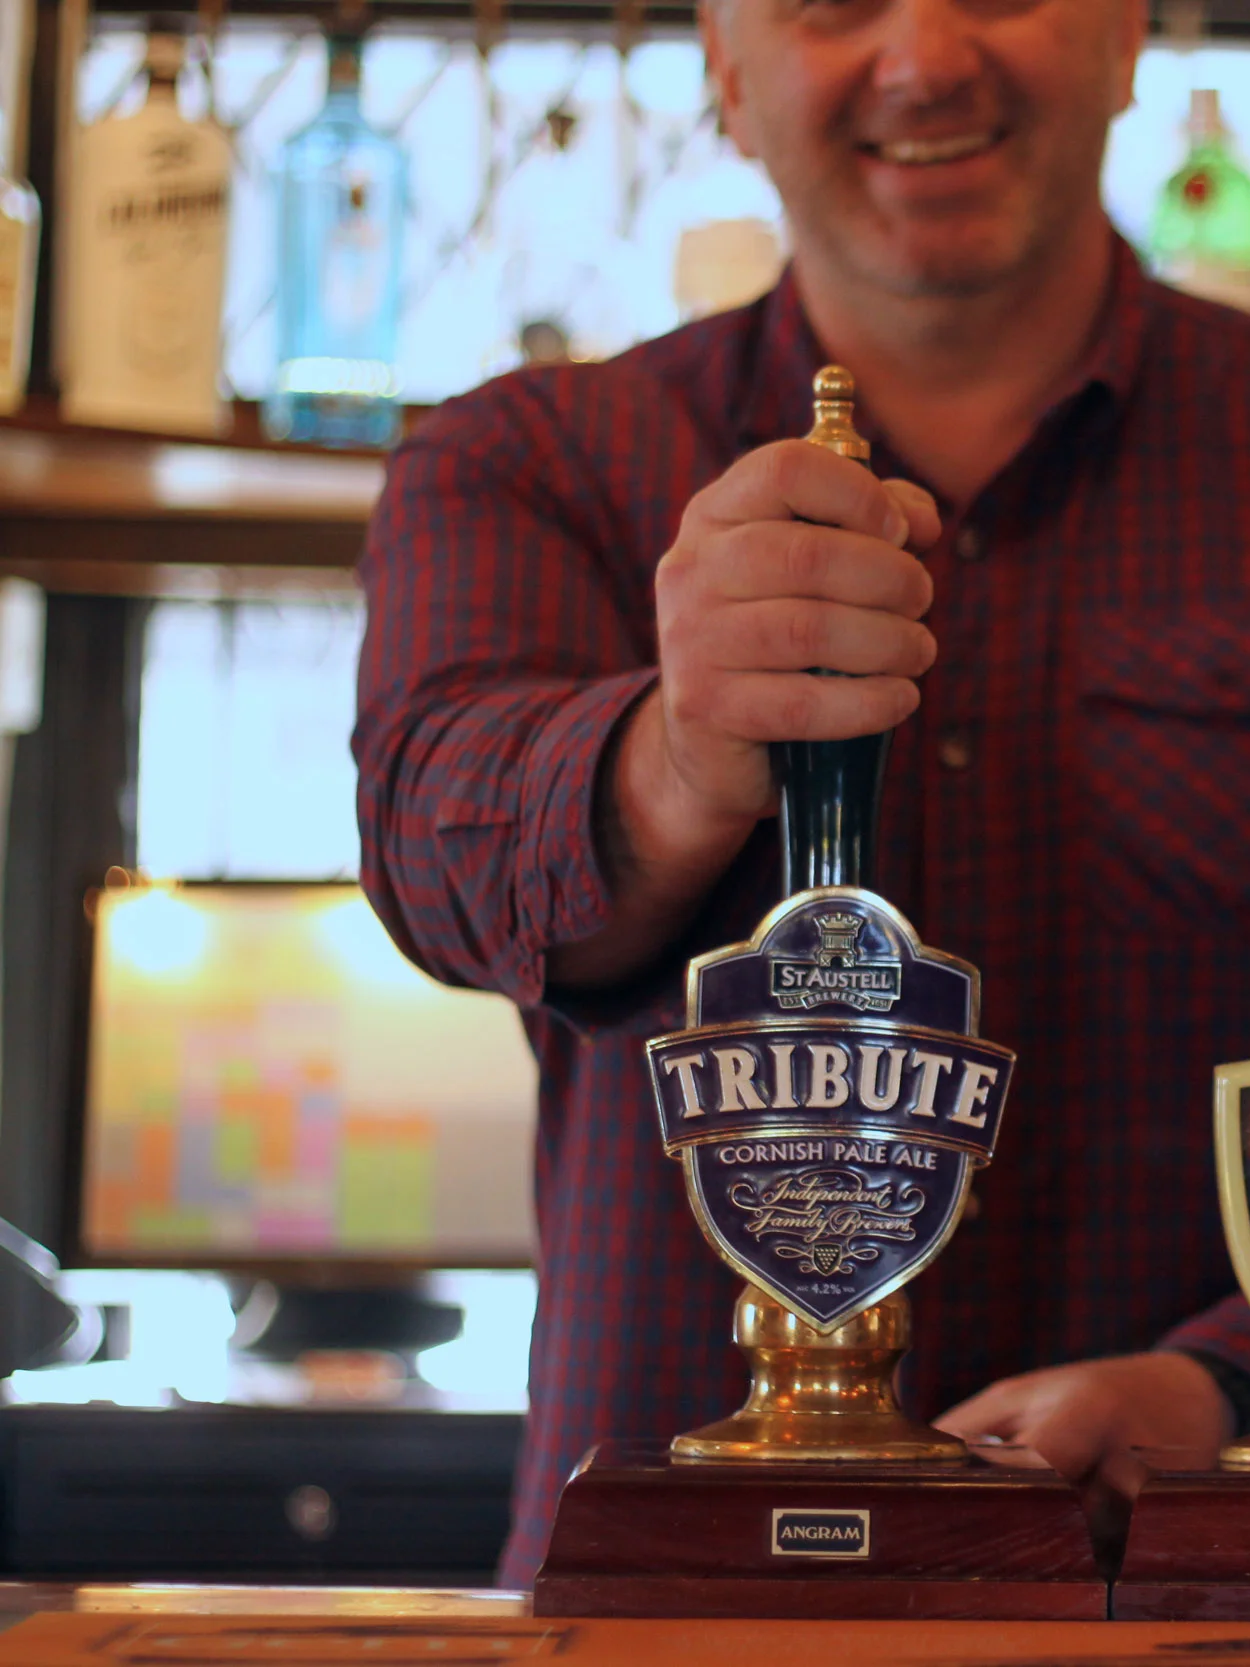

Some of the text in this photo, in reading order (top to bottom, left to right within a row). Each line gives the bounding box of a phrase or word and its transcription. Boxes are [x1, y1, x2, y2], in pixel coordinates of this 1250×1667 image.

[806, 967, 891, 989] AUSTELL
[807, 991, 866, 1007] BREWERY
[664, 1044, 998, 1129] TRIBUTE
[719, 1143, 938, 1170] CORNISH PALE ALE
[762, 1171, 892, 1210] Independent
[747, 1207, 913, 1243] Family Brewers
[811, 1283, 842, 1295] 4.2%
[780, 1525, 861, 1540] ANGRAM
